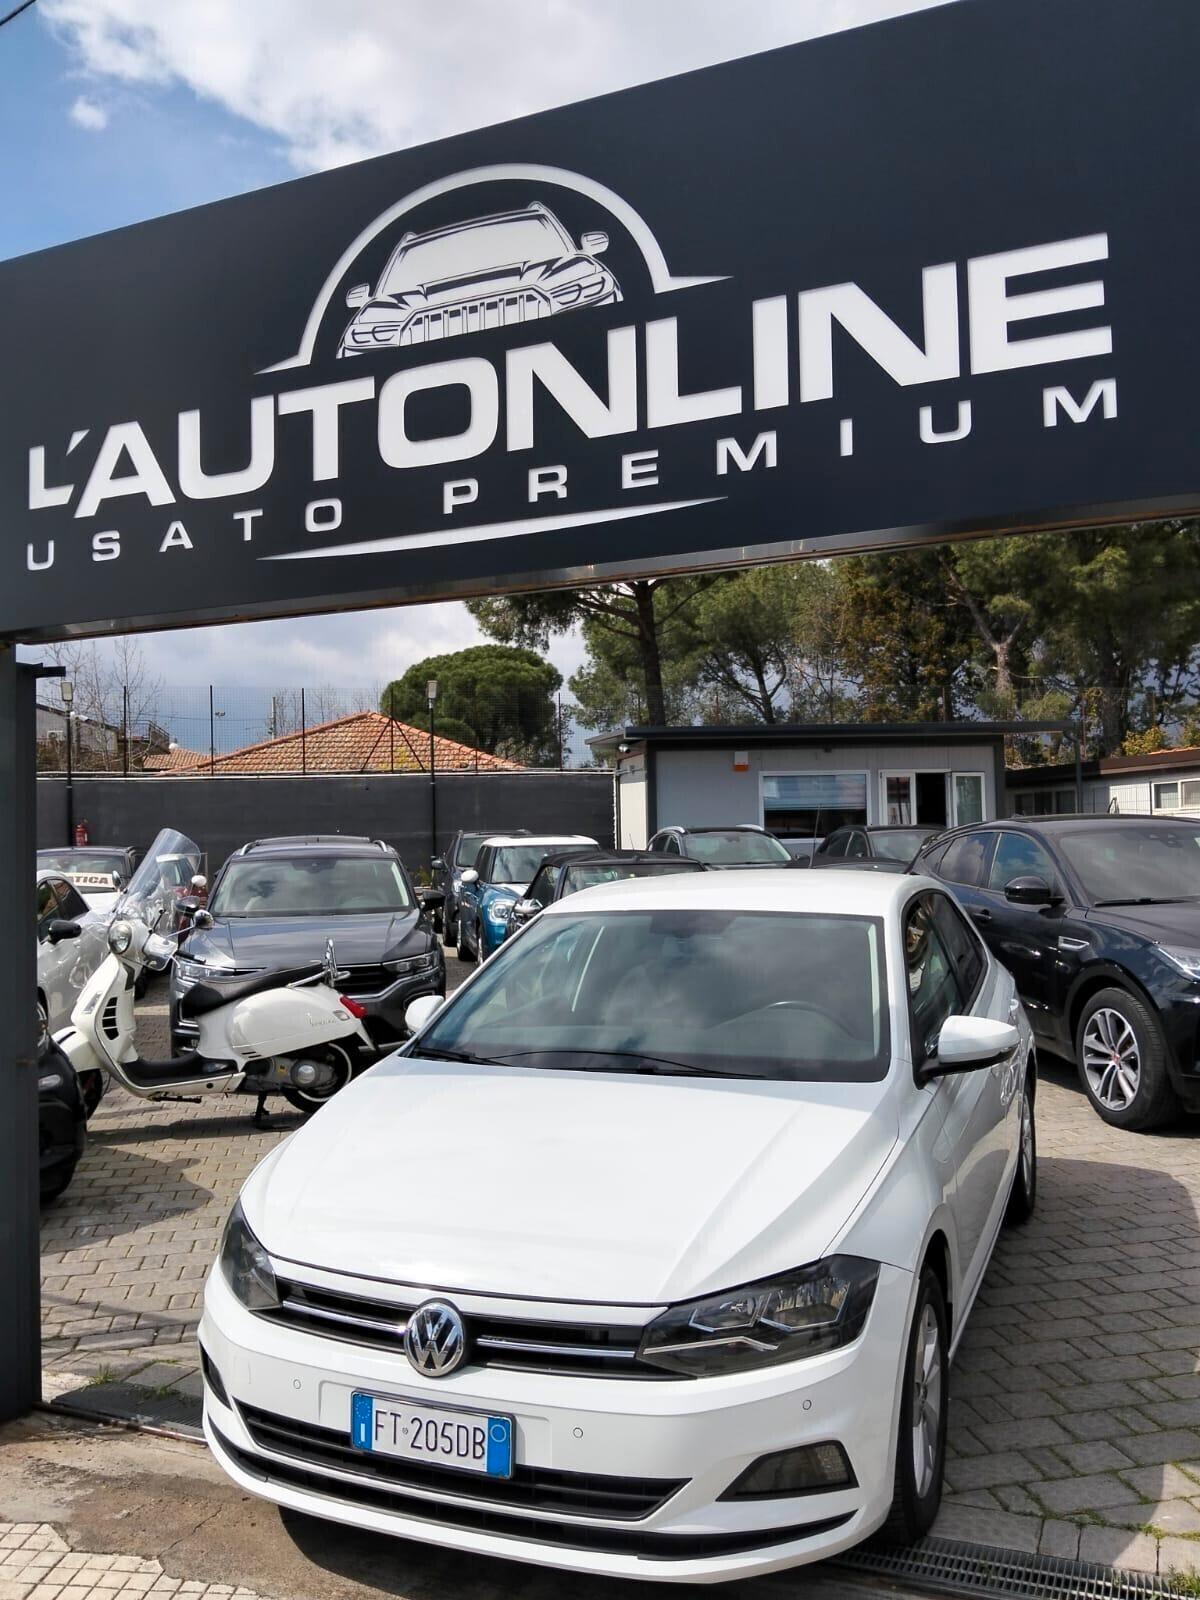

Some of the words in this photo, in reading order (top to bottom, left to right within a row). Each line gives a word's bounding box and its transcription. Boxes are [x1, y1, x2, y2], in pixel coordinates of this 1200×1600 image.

[26, 498, 342, 571] USATO
[443, 378, 1118, 514] PREMIUM
[28, 232, 1113, 518] L'AUTONLINE
